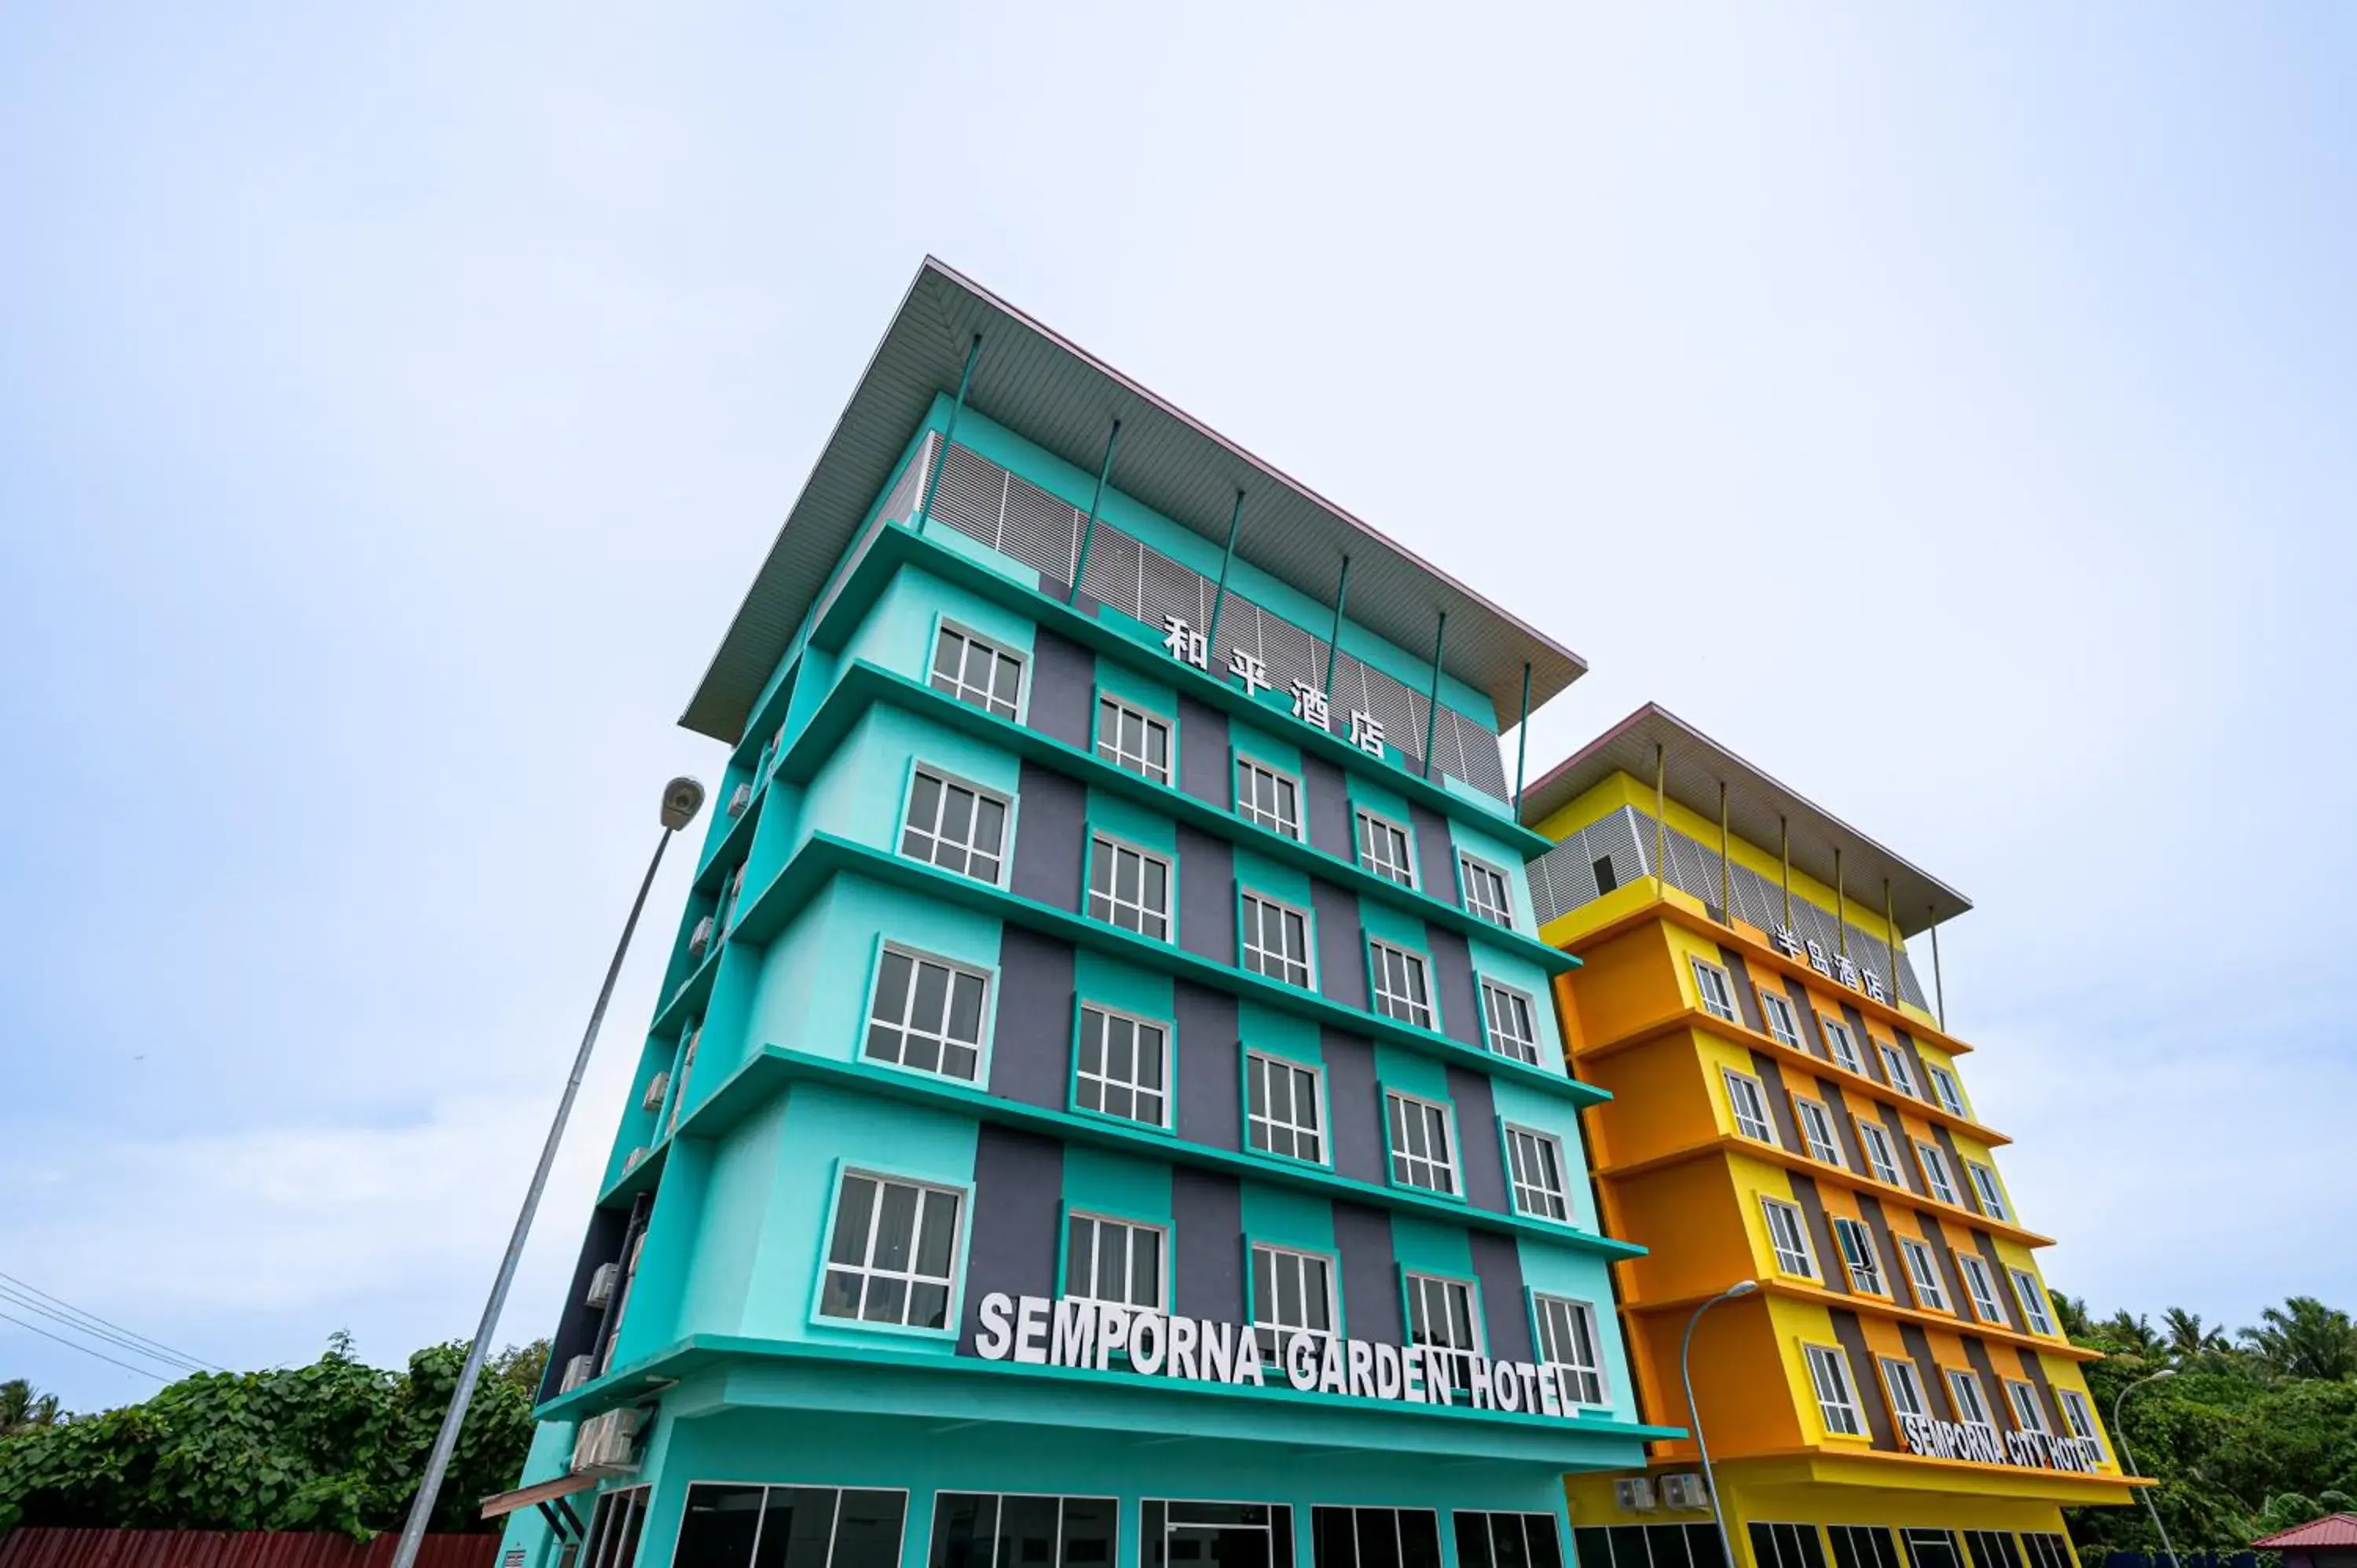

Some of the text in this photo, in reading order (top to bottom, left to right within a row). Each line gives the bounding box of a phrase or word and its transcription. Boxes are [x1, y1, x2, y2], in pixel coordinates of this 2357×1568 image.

[1163, 615, 1384, 759] 和平酒店
[1774, 923, 1886, 1003] 半岛酒店
[975, 1292, 1579, 1418] SEMPORNA GARDEN HOTEL
[1904, 1416, 2099, 1474] SEMPORNA CITY HOTEL
